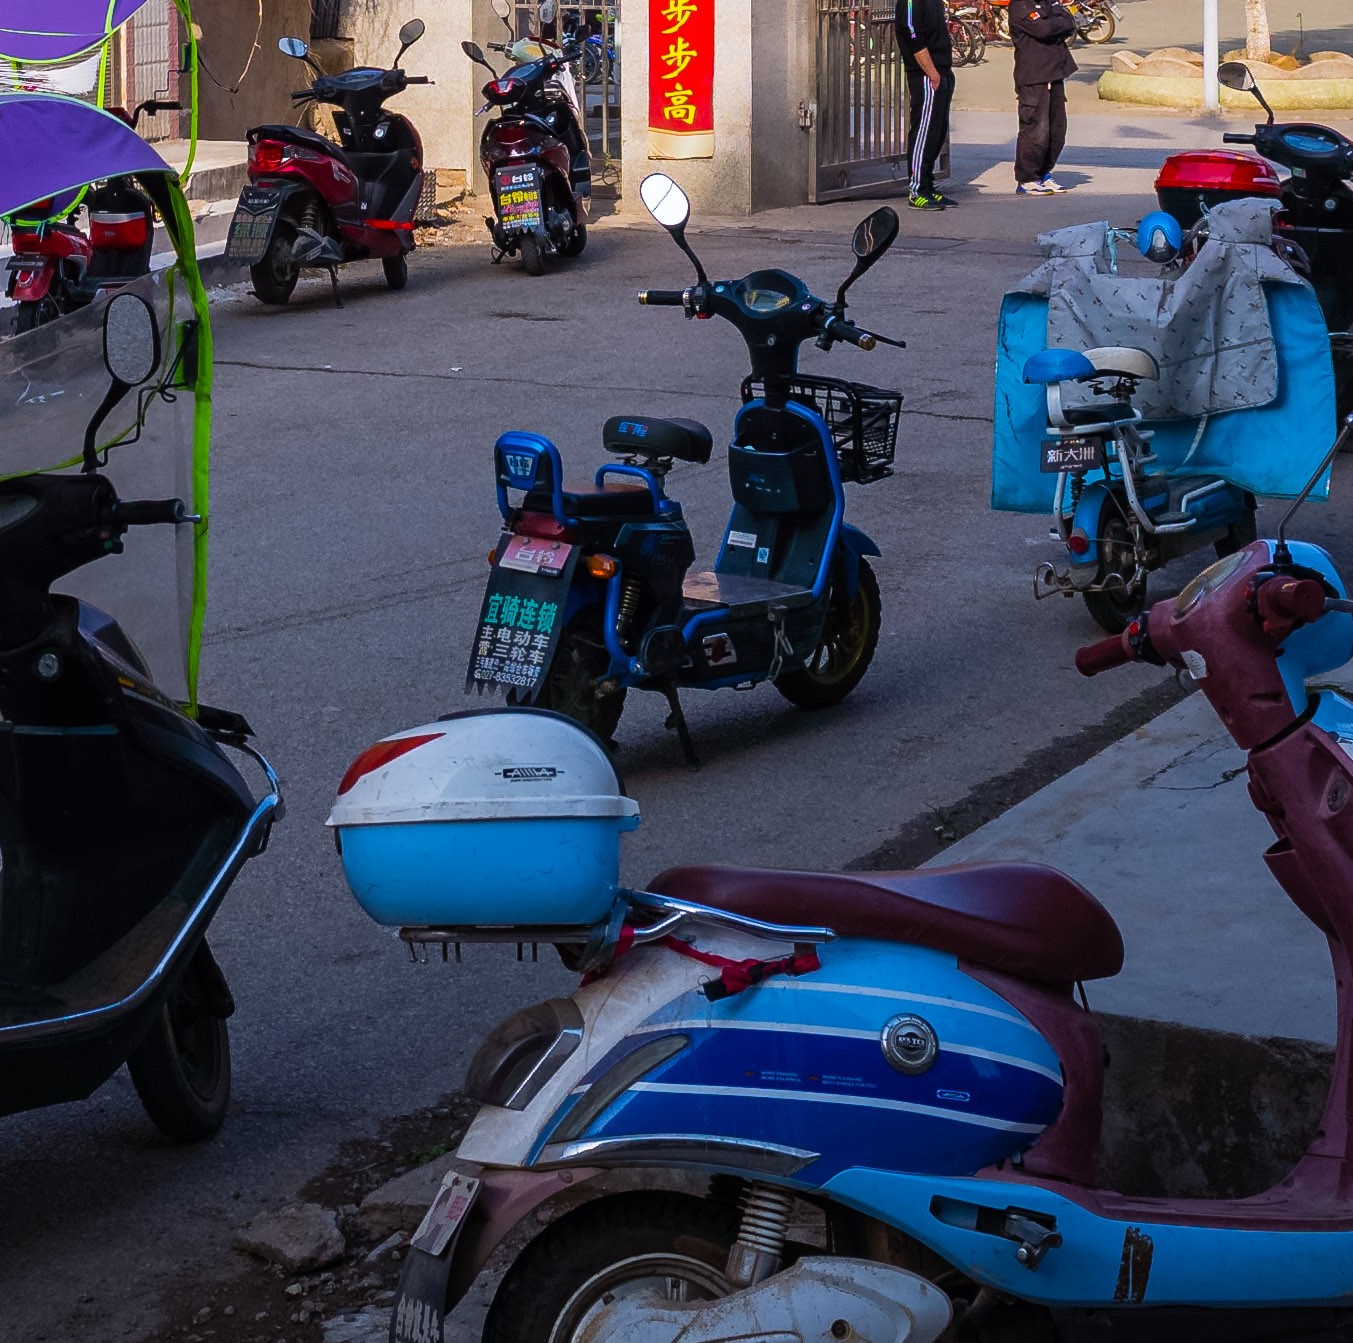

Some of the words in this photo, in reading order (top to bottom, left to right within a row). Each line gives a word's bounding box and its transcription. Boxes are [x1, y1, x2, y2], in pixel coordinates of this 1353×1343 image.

[1046, 446, 1096, 464] 新大洲
[484, 593, 558, 634] 宜骑连锁
